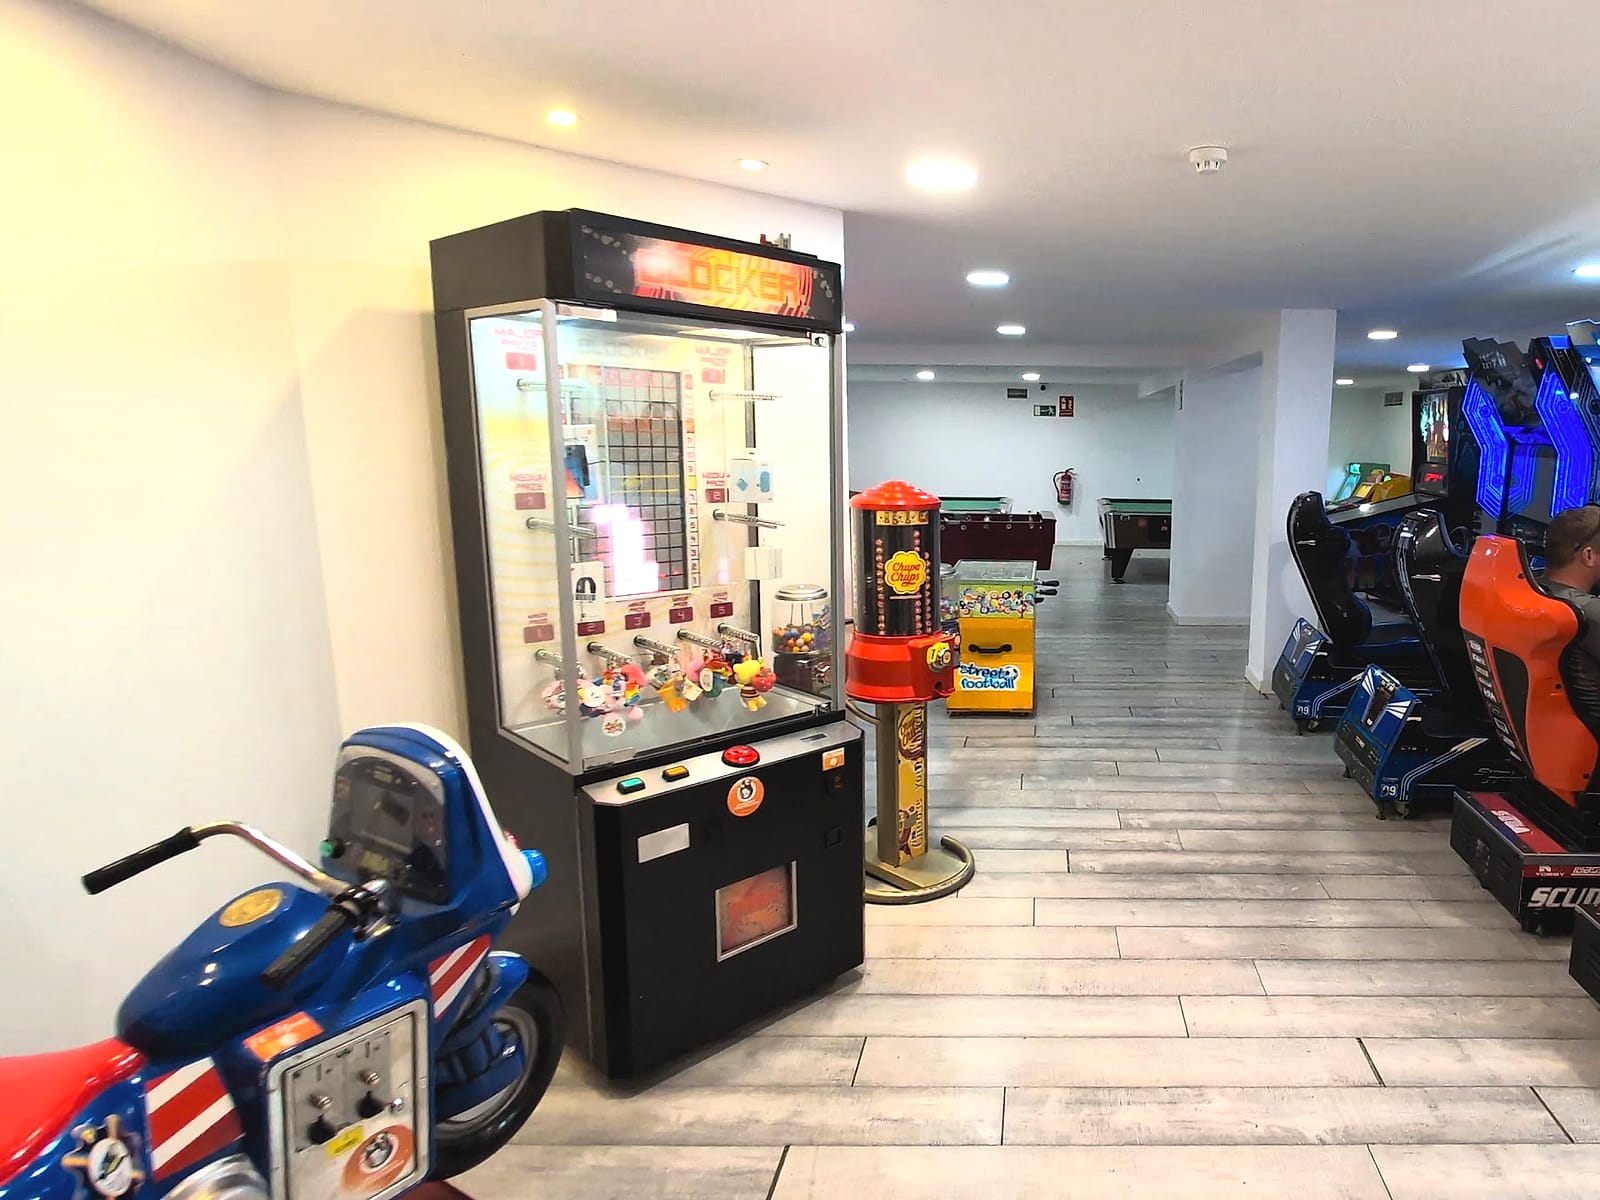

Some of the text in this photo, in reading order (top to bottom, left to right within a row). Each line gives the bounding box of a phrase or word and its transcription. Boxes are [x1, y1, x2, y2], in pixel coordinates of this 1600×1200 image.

[637, 248, 801, 305] LOCKER
[960, 663, 1005, 680] street
[961, 677, 1015, 689] football
